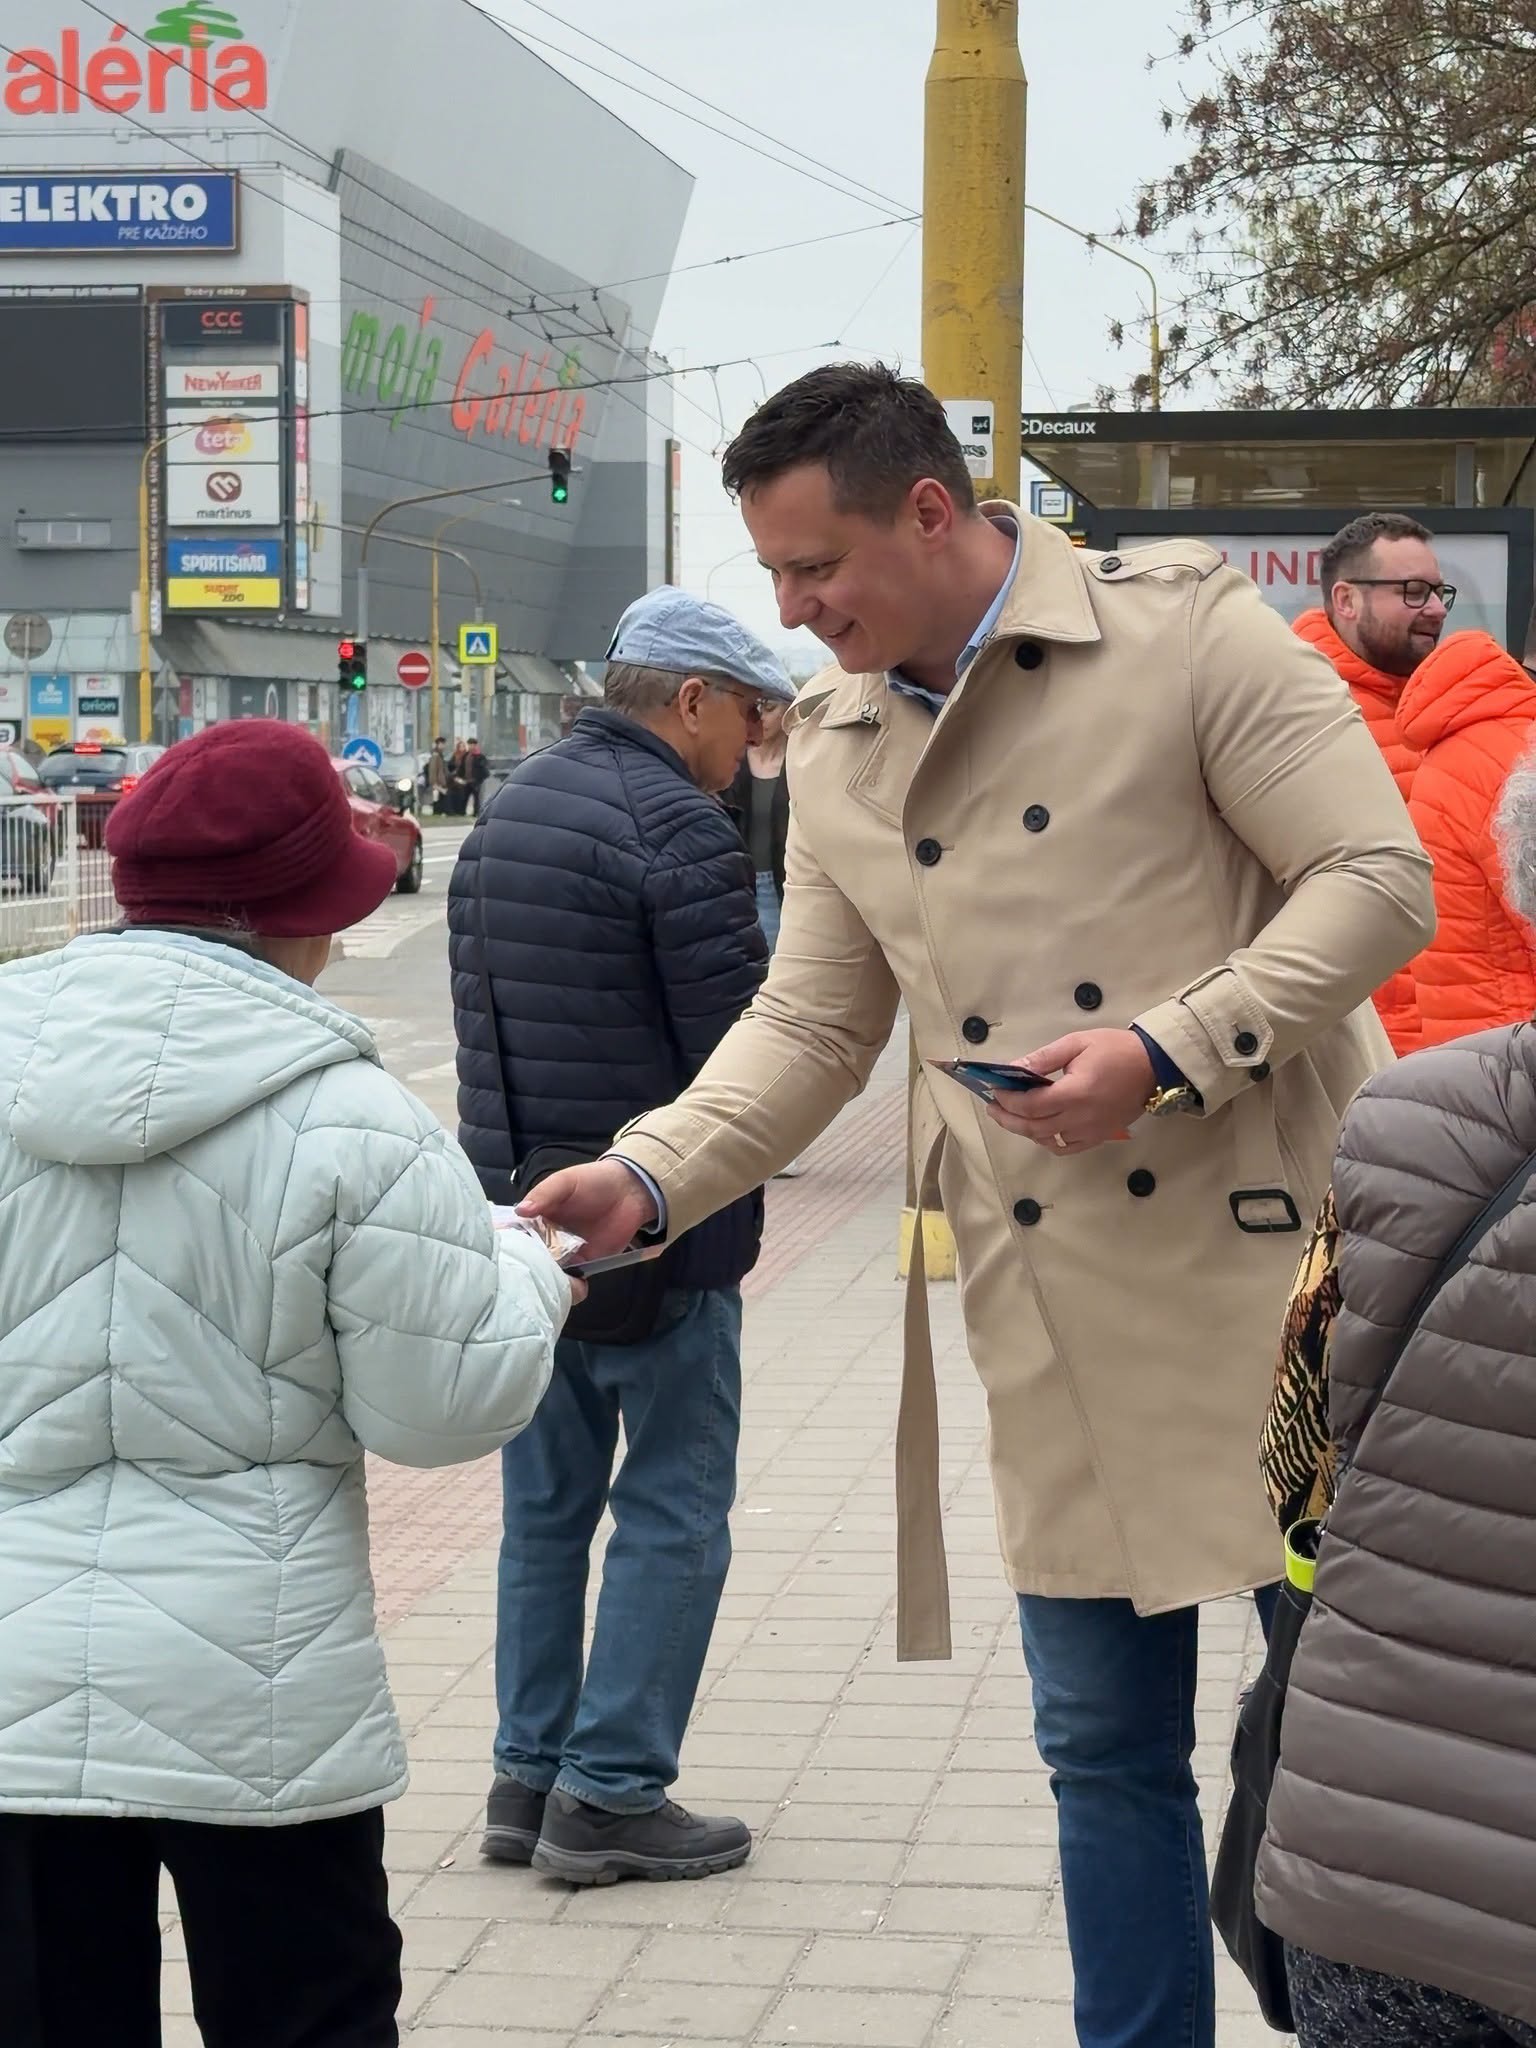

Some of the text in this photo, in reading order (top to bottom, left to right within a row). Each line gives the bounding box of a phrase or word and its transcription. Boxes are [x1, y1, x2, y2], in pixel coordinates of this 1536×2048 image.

[0, 184, 208, 222] ELEKTRO
[118, 224, 209, 240] PRE KAŽDÉHO
[201, 311, 244, 327] CCC
[196, 508, 252, 520] martinus
[181, 555, 267, 573] SPORTISIMO
